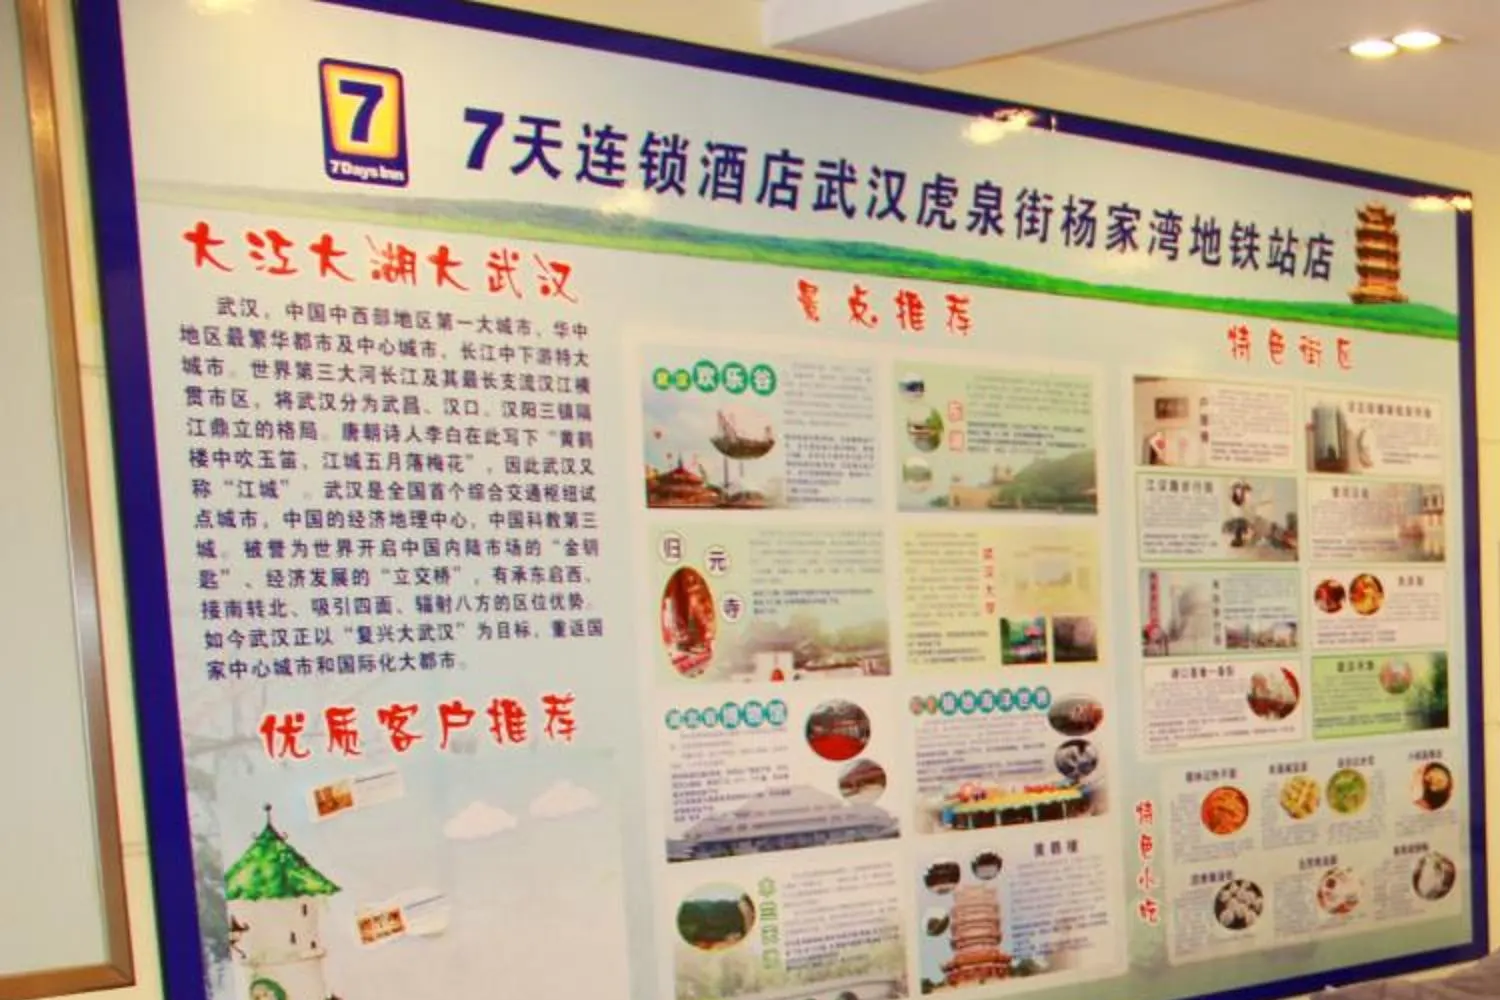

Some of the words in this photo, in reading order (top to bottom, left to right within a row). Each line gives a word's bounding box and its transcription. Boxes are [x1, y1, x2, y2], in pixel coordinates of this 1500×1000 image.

[339, 79, 384, 143] 7
[463, 107, 1335, 282] 7天连锁酒店武汉虎泉街杨家湾地铁站店
[182, 221, 577, 303] 大江大湖大武汉
[797, 279, 974, 337] 景点推荐
[1226, 323, 1355, 370] 特色街区
[258, 691, 577, 760] 优质客户推荐
